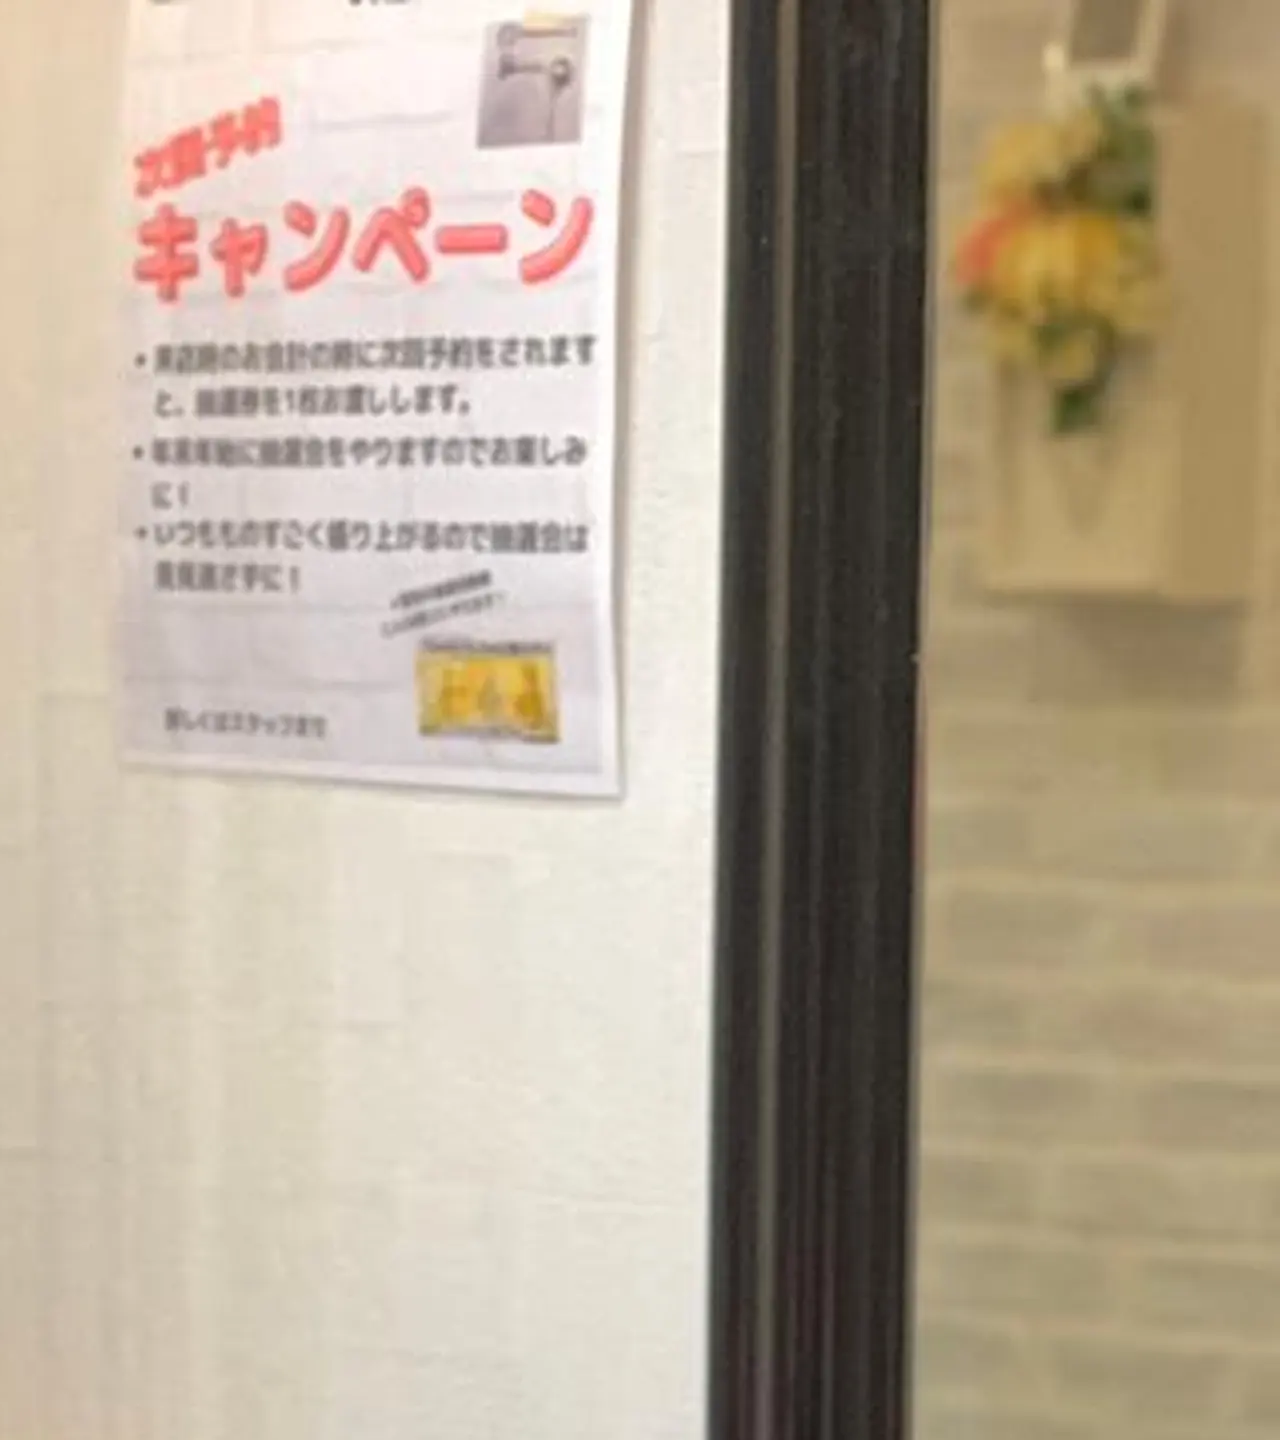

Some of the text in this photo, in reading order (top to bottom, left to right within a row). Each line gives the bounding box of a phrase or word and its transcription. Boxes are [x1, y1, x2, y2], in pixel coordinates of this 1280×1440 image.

[134, 187, 594, 302] キャンペーン
